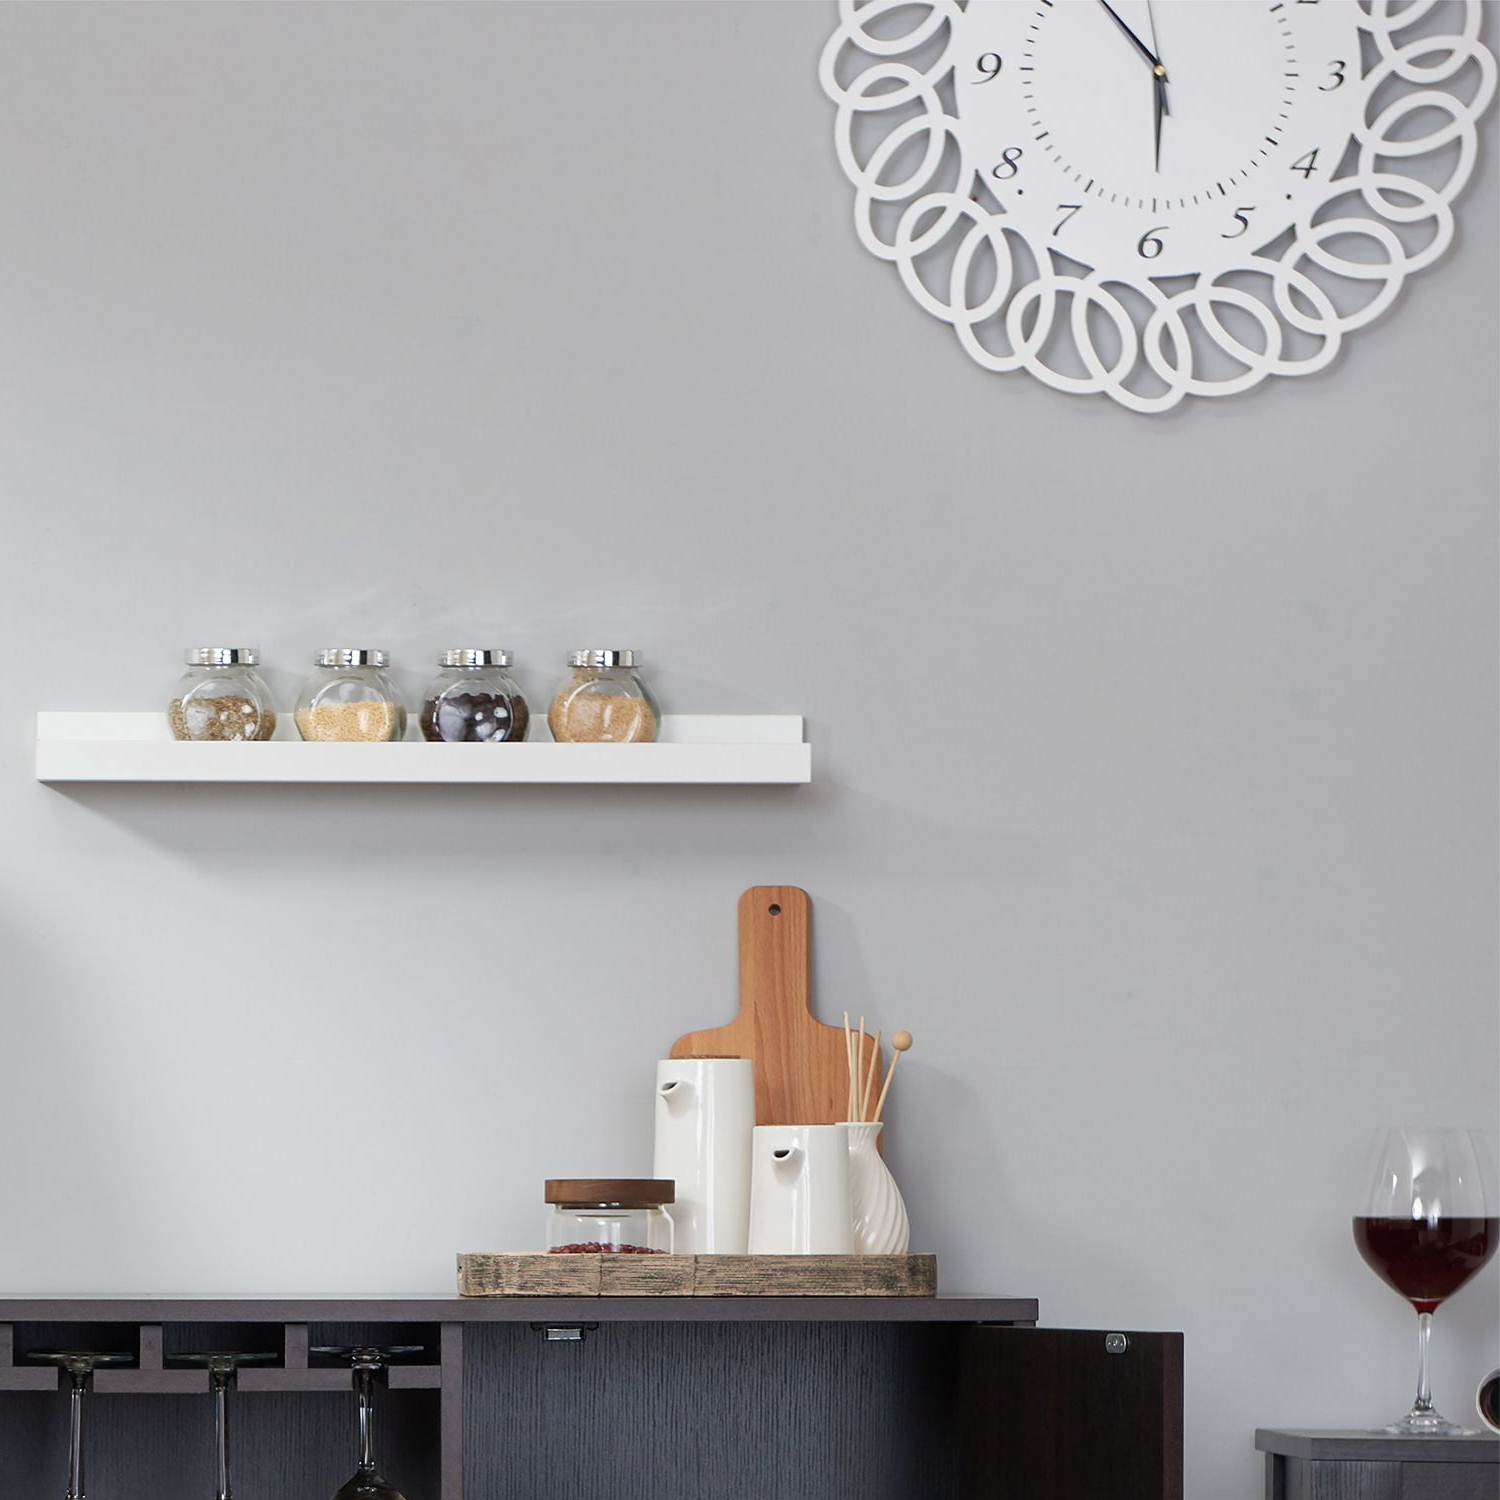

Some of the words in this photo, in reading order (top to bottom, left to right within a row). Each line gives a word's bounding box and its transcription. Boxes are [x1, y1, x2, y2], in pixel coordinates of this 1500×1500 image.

[971, 52, 1002, 85] 9
[1317, 60, 1347, 92] 3
[992, 146, 1024, 179] 8
[1289, 147, 1320, 180] 4
[1051, 204, 1083, 237] 7
[1220, 206, 1257, 239] 5
[1137, 226, 1170, 260] 6
